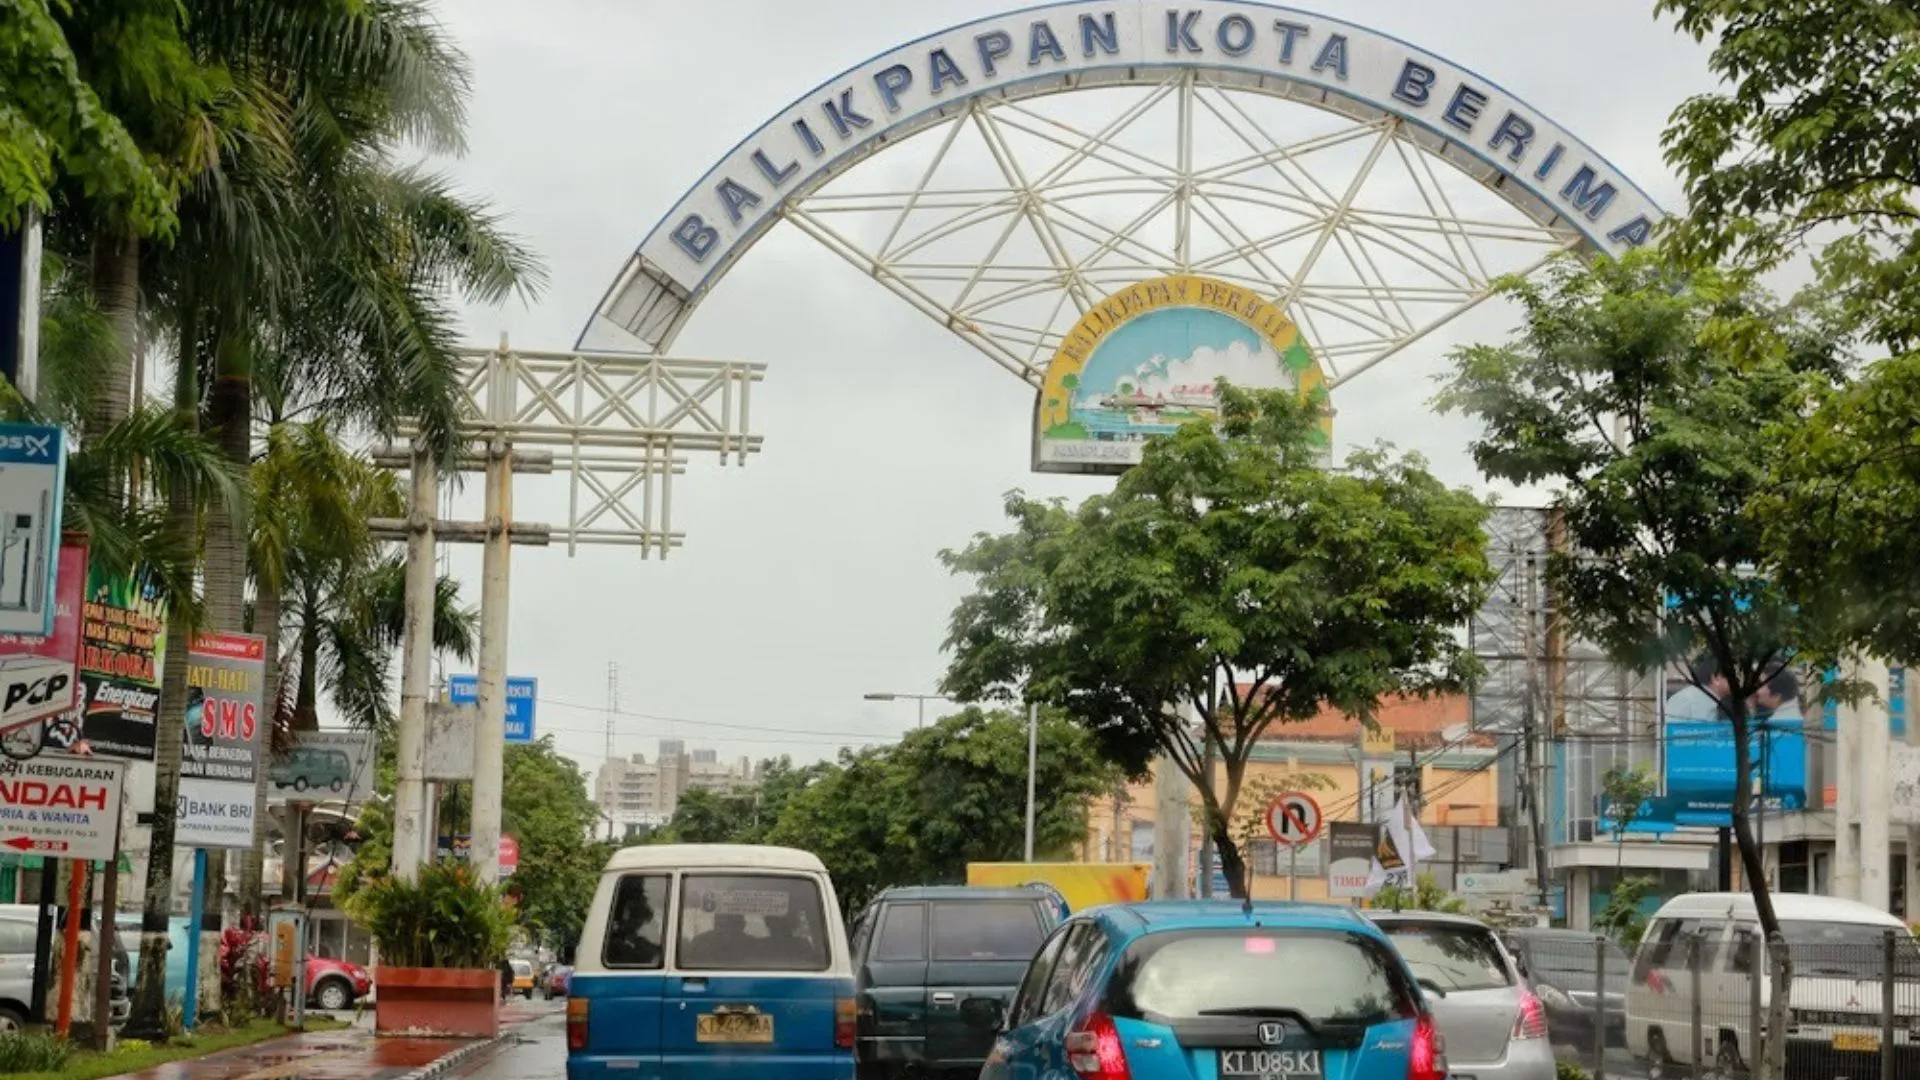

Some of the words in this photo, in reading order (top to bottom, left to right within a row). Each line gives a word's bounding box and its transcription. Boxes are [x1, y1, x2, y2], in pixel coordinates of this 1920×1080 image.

[669, 11, 1120, 263] BALIKPAPAN
[1166, 9, 1349, 81] KOTA
[1391, 57, 1657, 249] BERIMA
[1063, 279, 1187, 364] BALIKPAPAN
[94, 681, 158, 709] Energizer
[201, 696, 256, 740] SMS
[1366, 732, 1391, 743] ATM
[26, 763, 115, 781] KEBUGARAN
[0, 779, 107, 811] NDAH
[0, 808, 24, 820] RIA
[28, 810, 37, 820] &
[42, 811, 90, 825] WANITA
[189, 801, 227, 817] BANK
[230, 804, 252, 818] BRI
[1221, 1050, 1246, 1073] KT
[1251, 1050, 1295, 1073] 1085
[1298, 1050, 1320, 1074] KI
